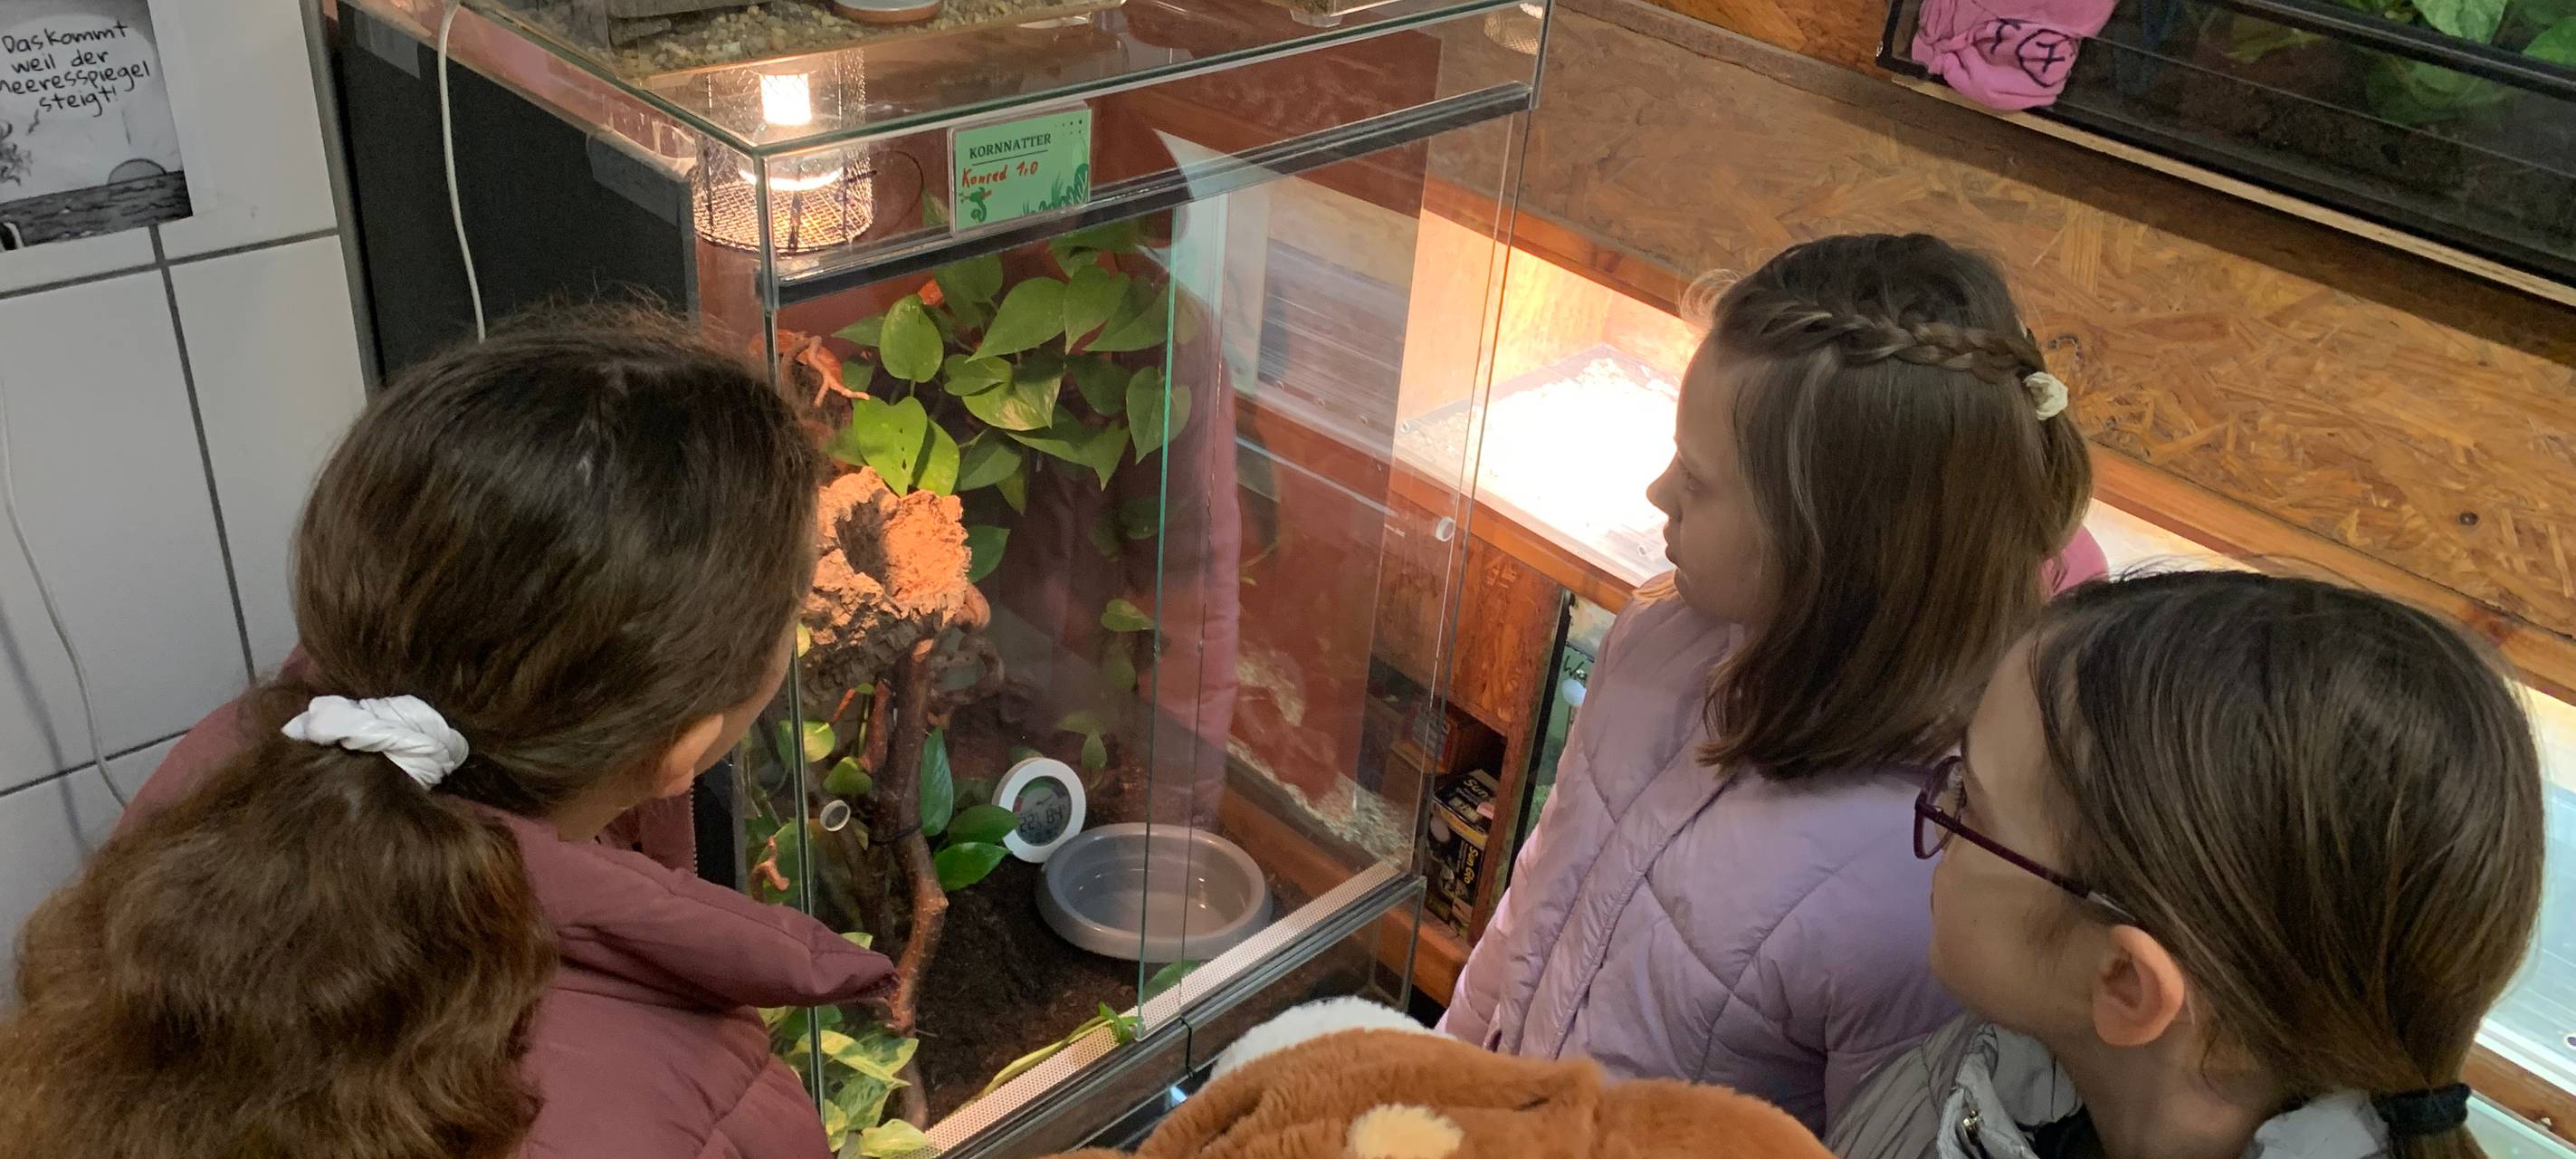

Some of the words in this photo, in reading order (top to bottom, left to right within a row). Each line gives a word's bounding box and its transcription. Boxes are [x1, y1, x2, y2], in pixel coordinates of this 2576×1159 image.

[11, 53, 57, 73] weil
[71, 49, 110, 68] der
[39, 85, 118, 117] steigt!
[969, 133, 1051, 158] KORNNATTER
[961, 165, 1008, 188] Konrad
[1463, 779, 1489, 798] Sun
[1466, 846, 1479, 867] Sun
[1464, 867, 1475, 884] Glo
